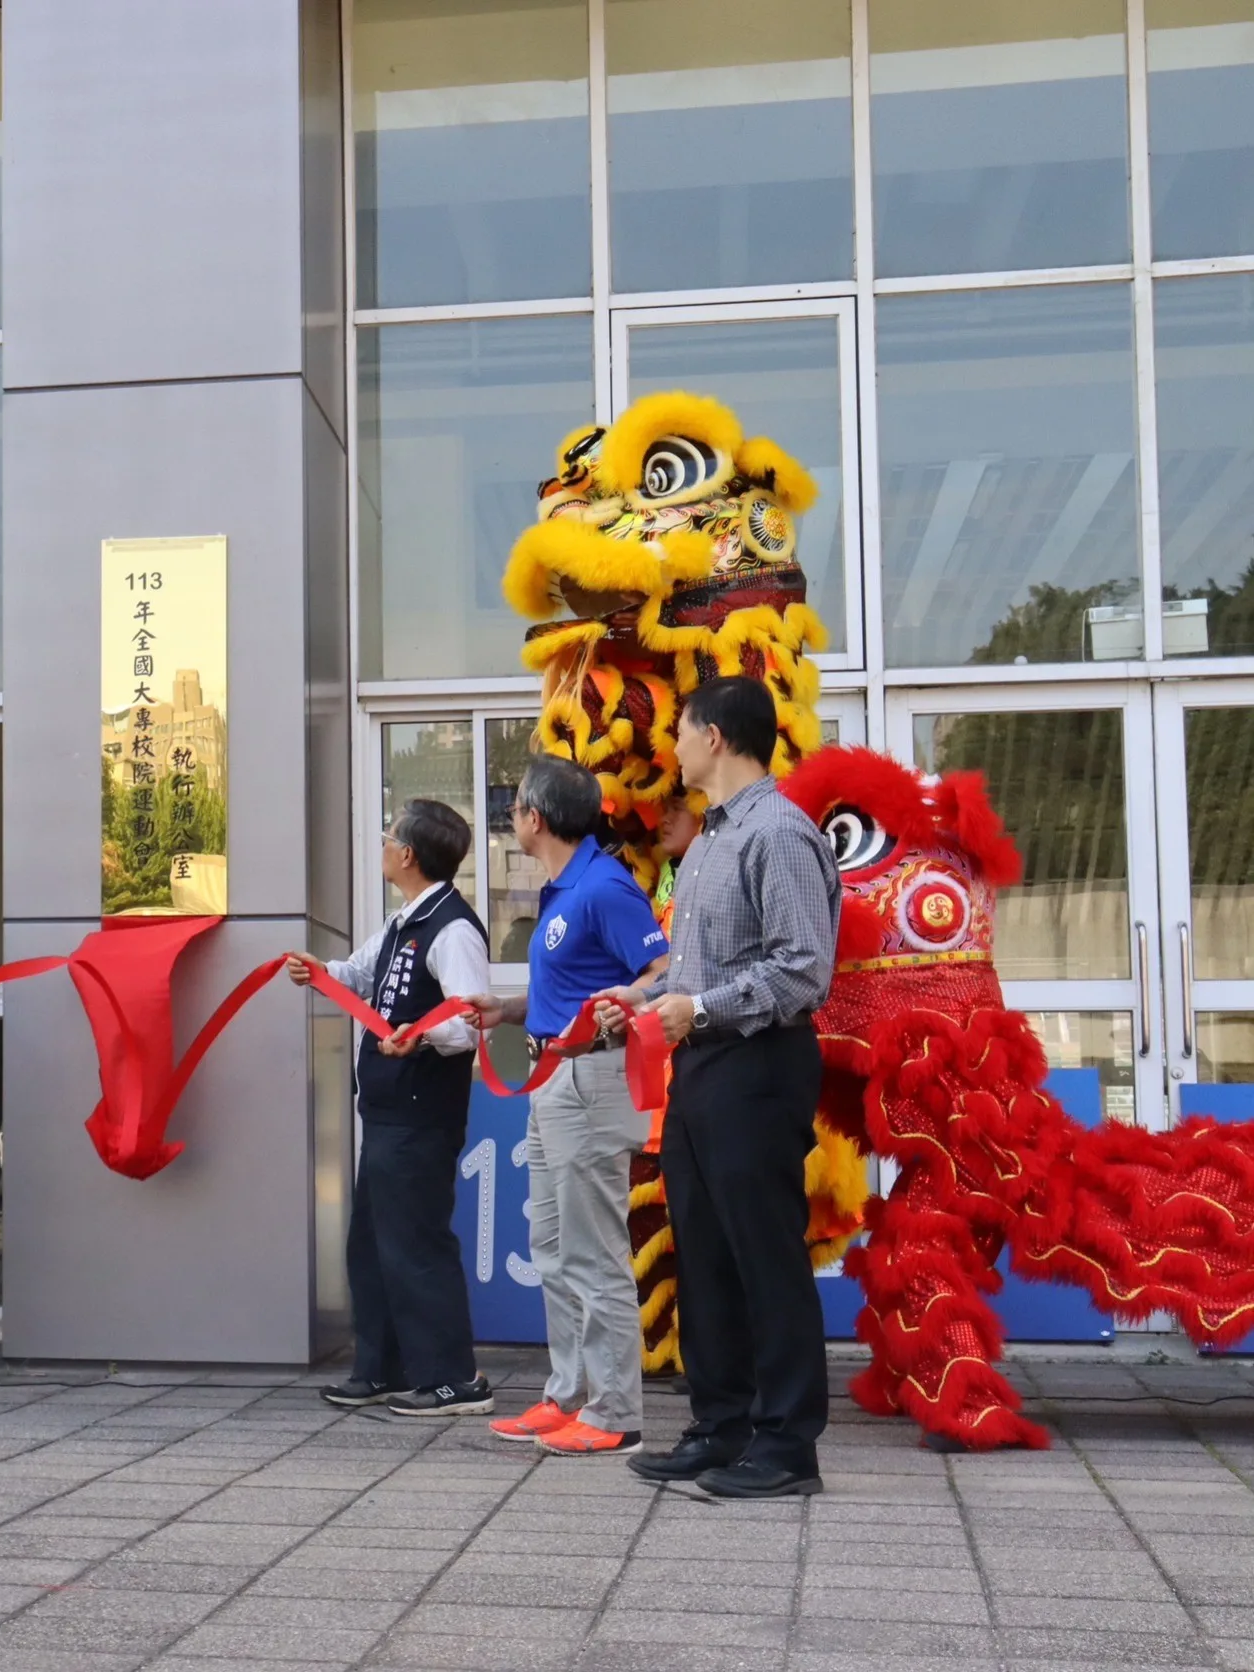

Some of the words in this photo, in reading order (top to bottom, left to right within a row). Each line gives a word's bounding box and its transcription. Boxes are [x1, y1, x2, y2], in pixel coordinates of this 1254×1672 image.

[170, 747, 196, 880] 執行辦公室
